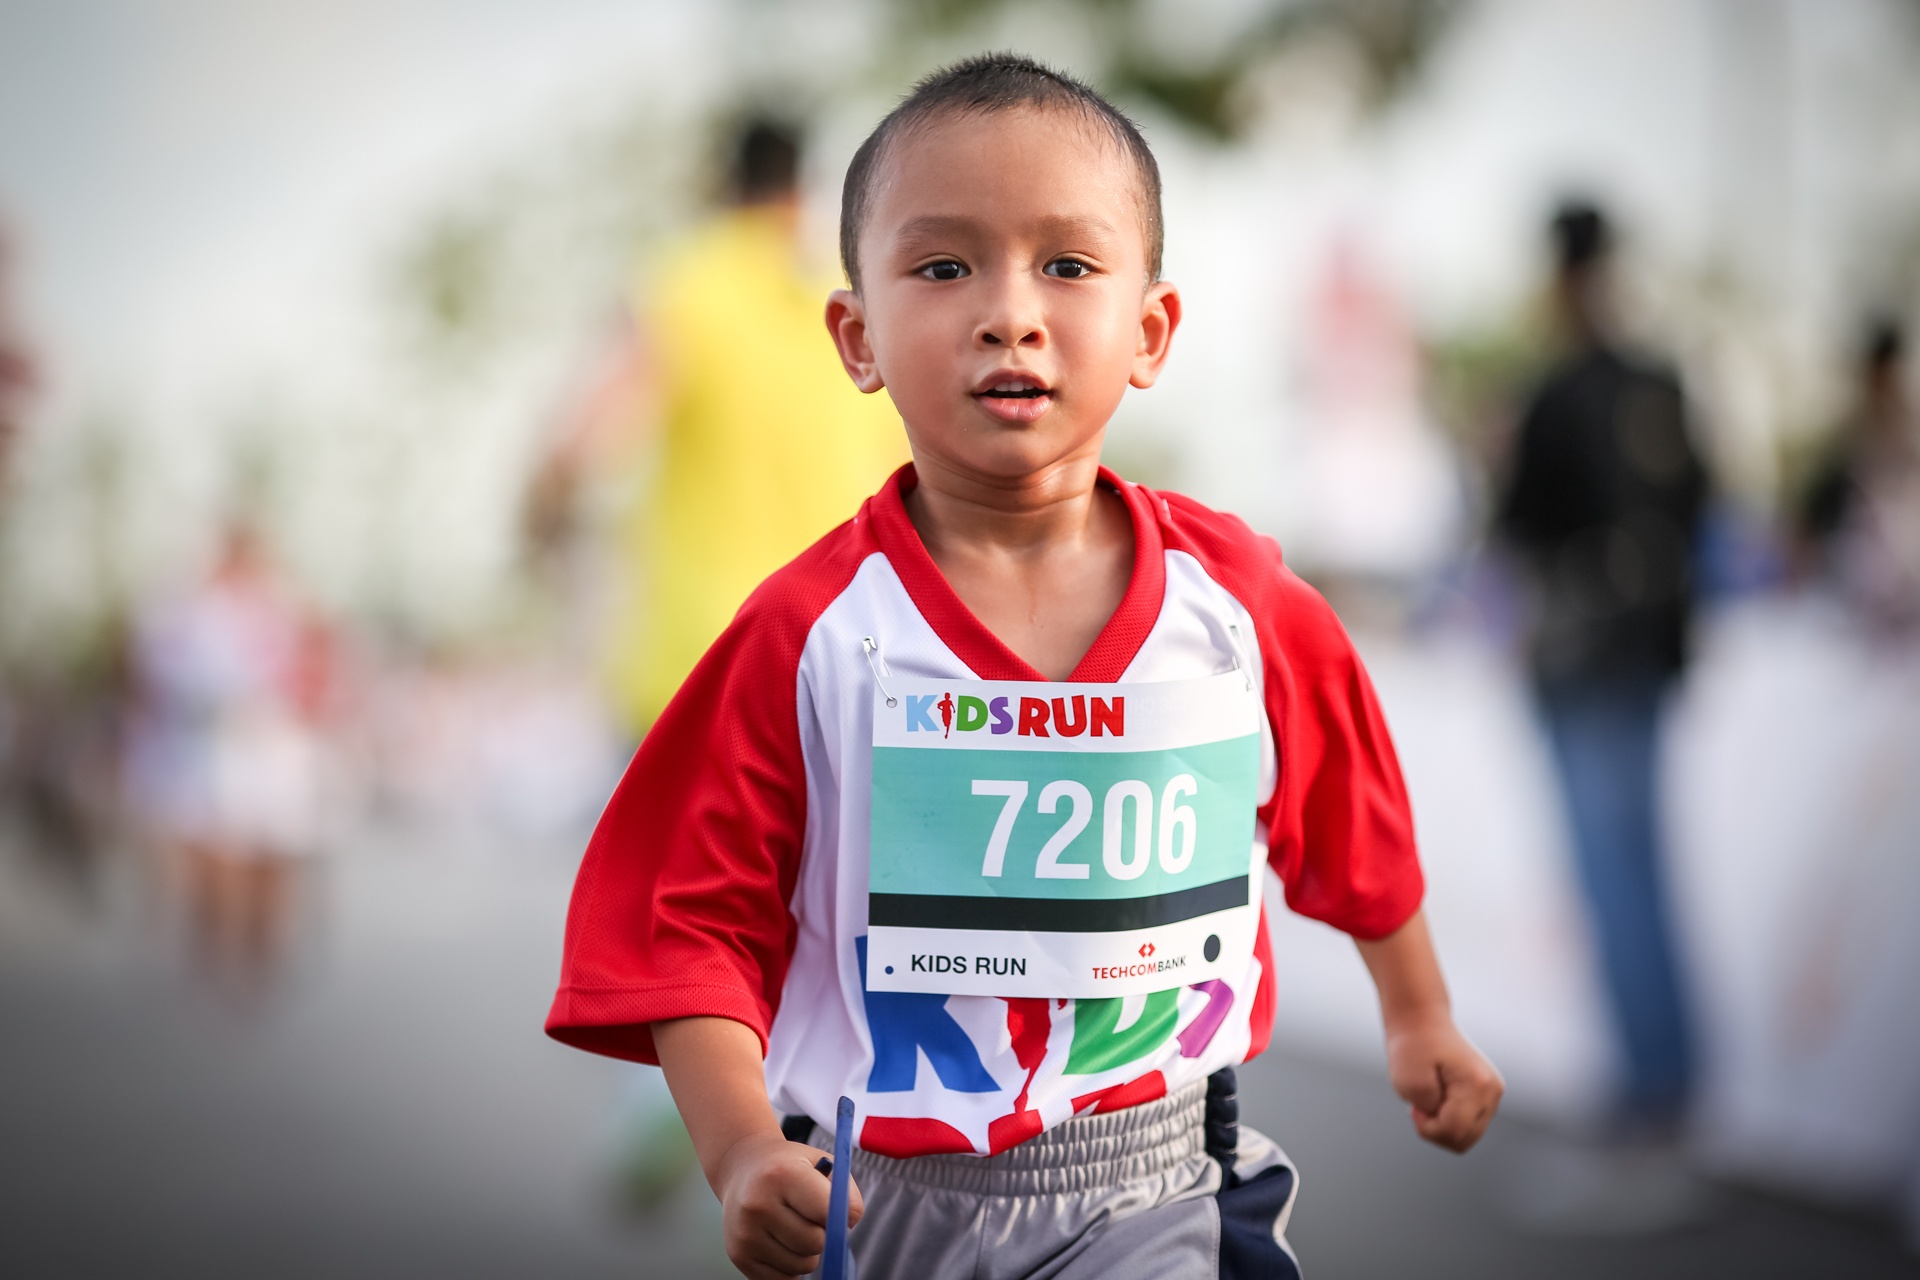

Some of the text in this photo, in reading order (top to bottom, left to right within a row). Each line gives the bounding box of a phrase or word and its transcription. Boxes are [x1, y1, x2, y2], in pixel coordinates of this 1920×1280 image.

[971, 774, 1198, 881] 7206
[911, 954, 1027, 976] KIDS RUN
[1092, 956, 1187, 980] TECHCOMBANK
